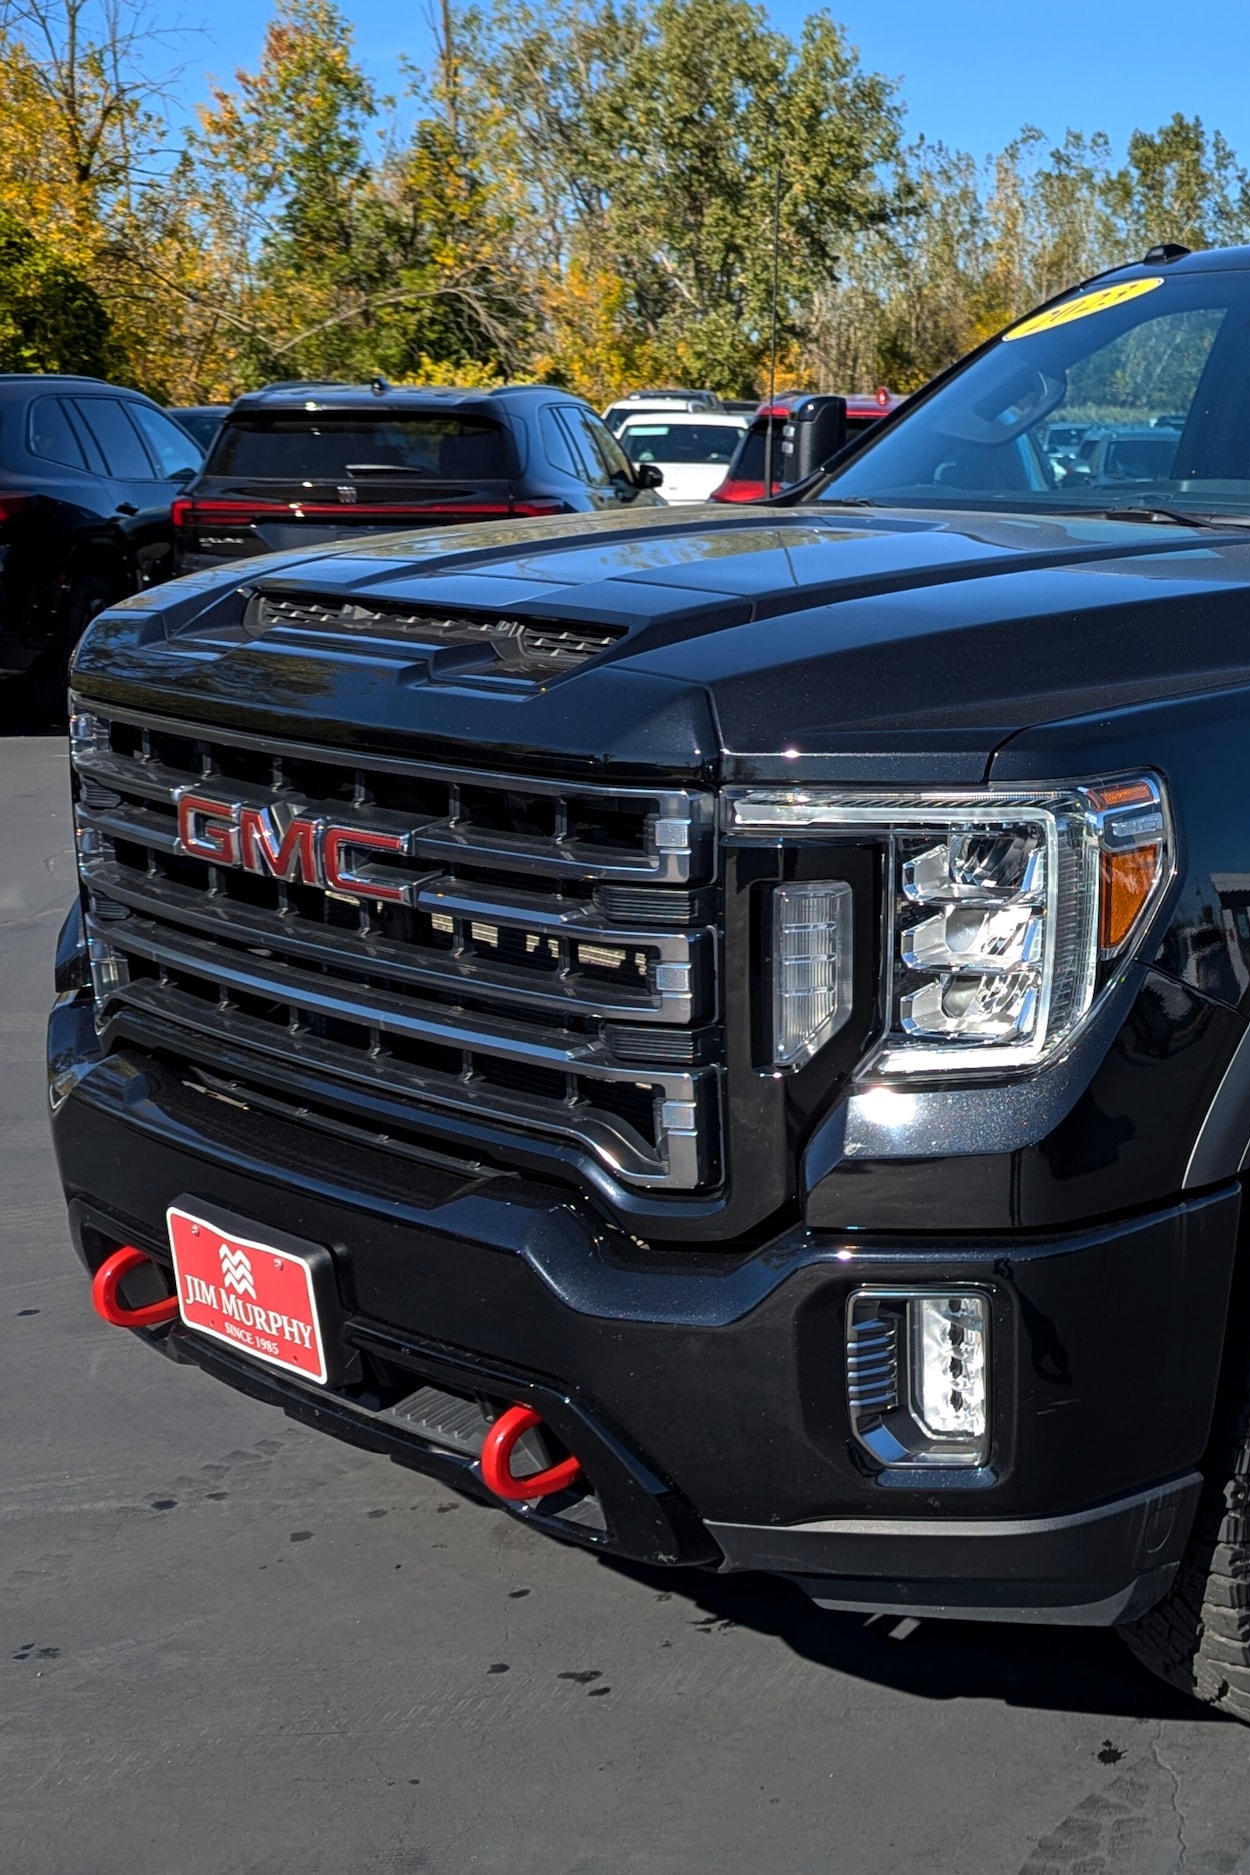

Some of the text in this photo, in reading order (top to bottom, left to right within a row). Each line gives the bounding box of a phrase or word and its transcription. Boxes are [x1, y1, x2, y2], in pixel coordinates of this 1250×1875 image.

[178, 794, 412, 905] GMC
[184, 1274, 313, 1350] JIM MURPHY
[224, 1322, 279, 1355] SINCE 1985
